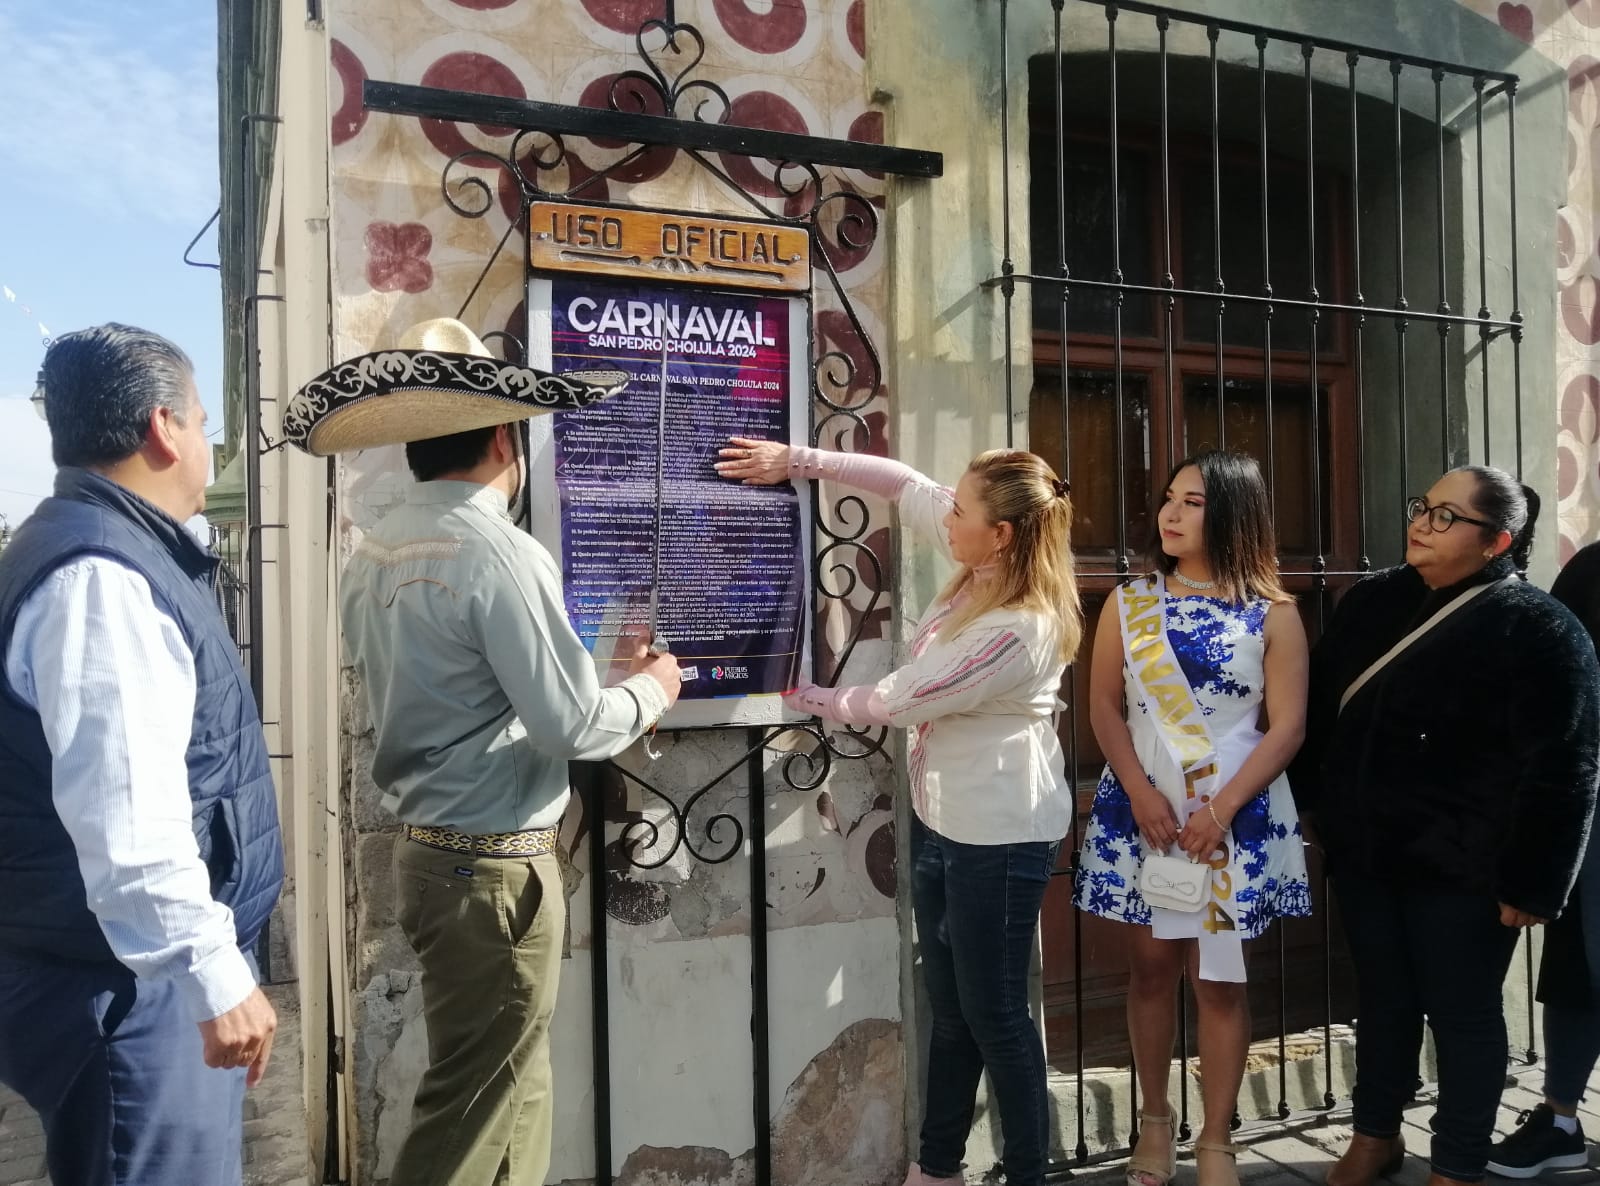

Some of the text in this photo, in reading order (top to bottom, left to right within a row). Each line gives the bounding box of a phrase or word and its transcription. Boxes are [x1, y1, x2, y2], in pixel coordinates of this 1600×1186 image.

[551, 212, 793, 266] USO OFICIAL
[568, 296, 775, 347] CARNAVAL
[588, 334, 757, 358] SAN PEDRO CHOLULA 2024
[682, 376, 698, 385] SAN
[699, 377, 726, 387] PEDRO
[727, 379, 763, 389] CHOLULA
[763, 381, 780, 391] 2024
[1203, 841, 1236, 935] 024
